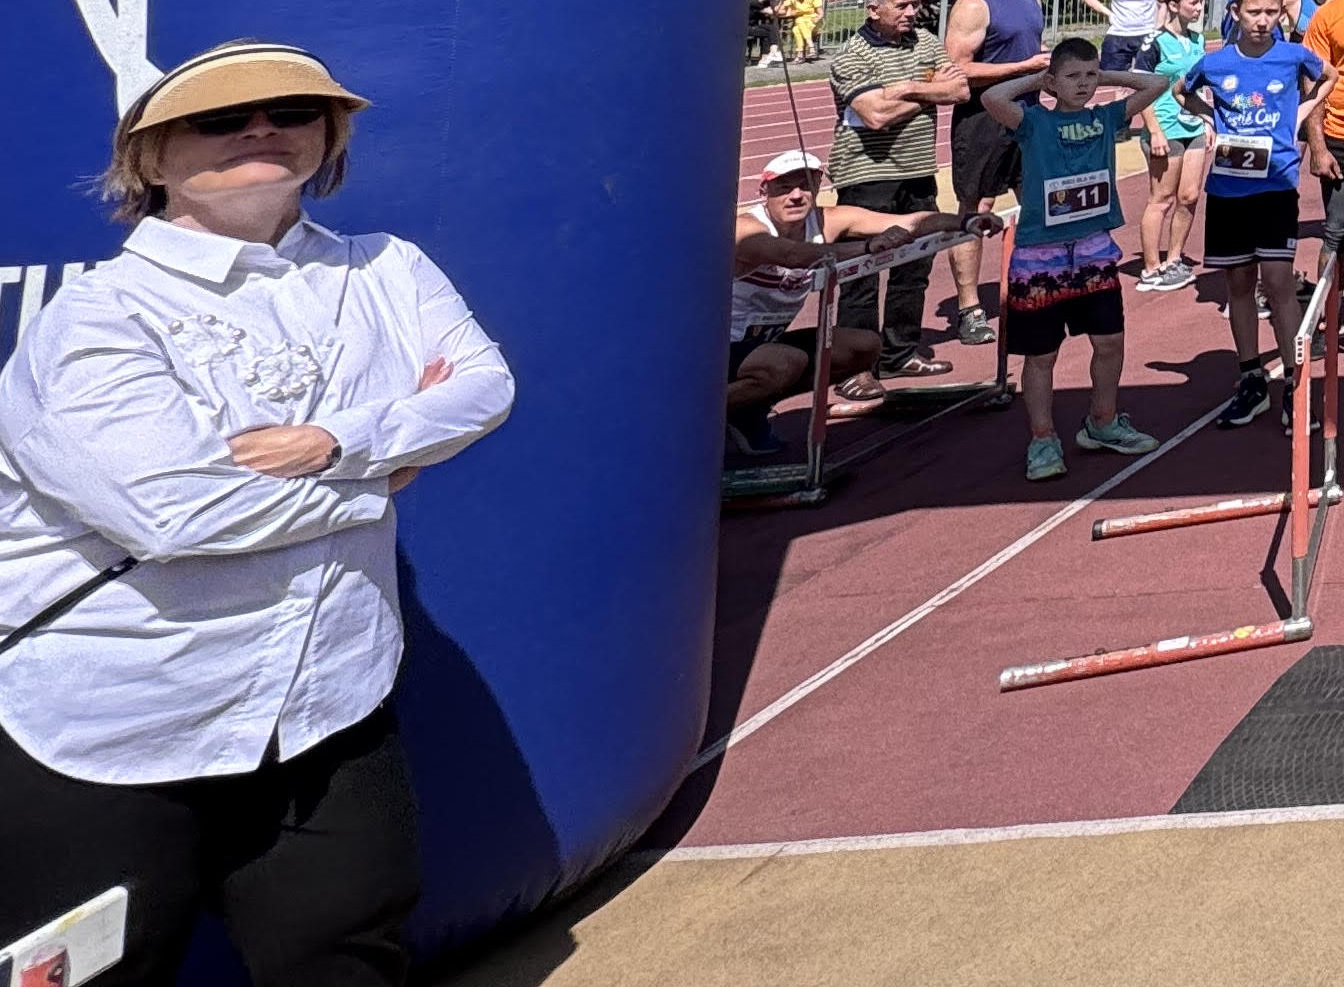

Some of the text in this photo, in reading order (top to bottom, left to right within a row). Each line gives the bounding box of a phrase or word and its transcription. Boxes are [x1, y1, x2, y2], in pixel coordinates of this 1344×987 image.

[1254, 108, 1281, 129] Cup
[1242, 150, 1256, 168] 2
[1076, 185, 1100, 207] 11
